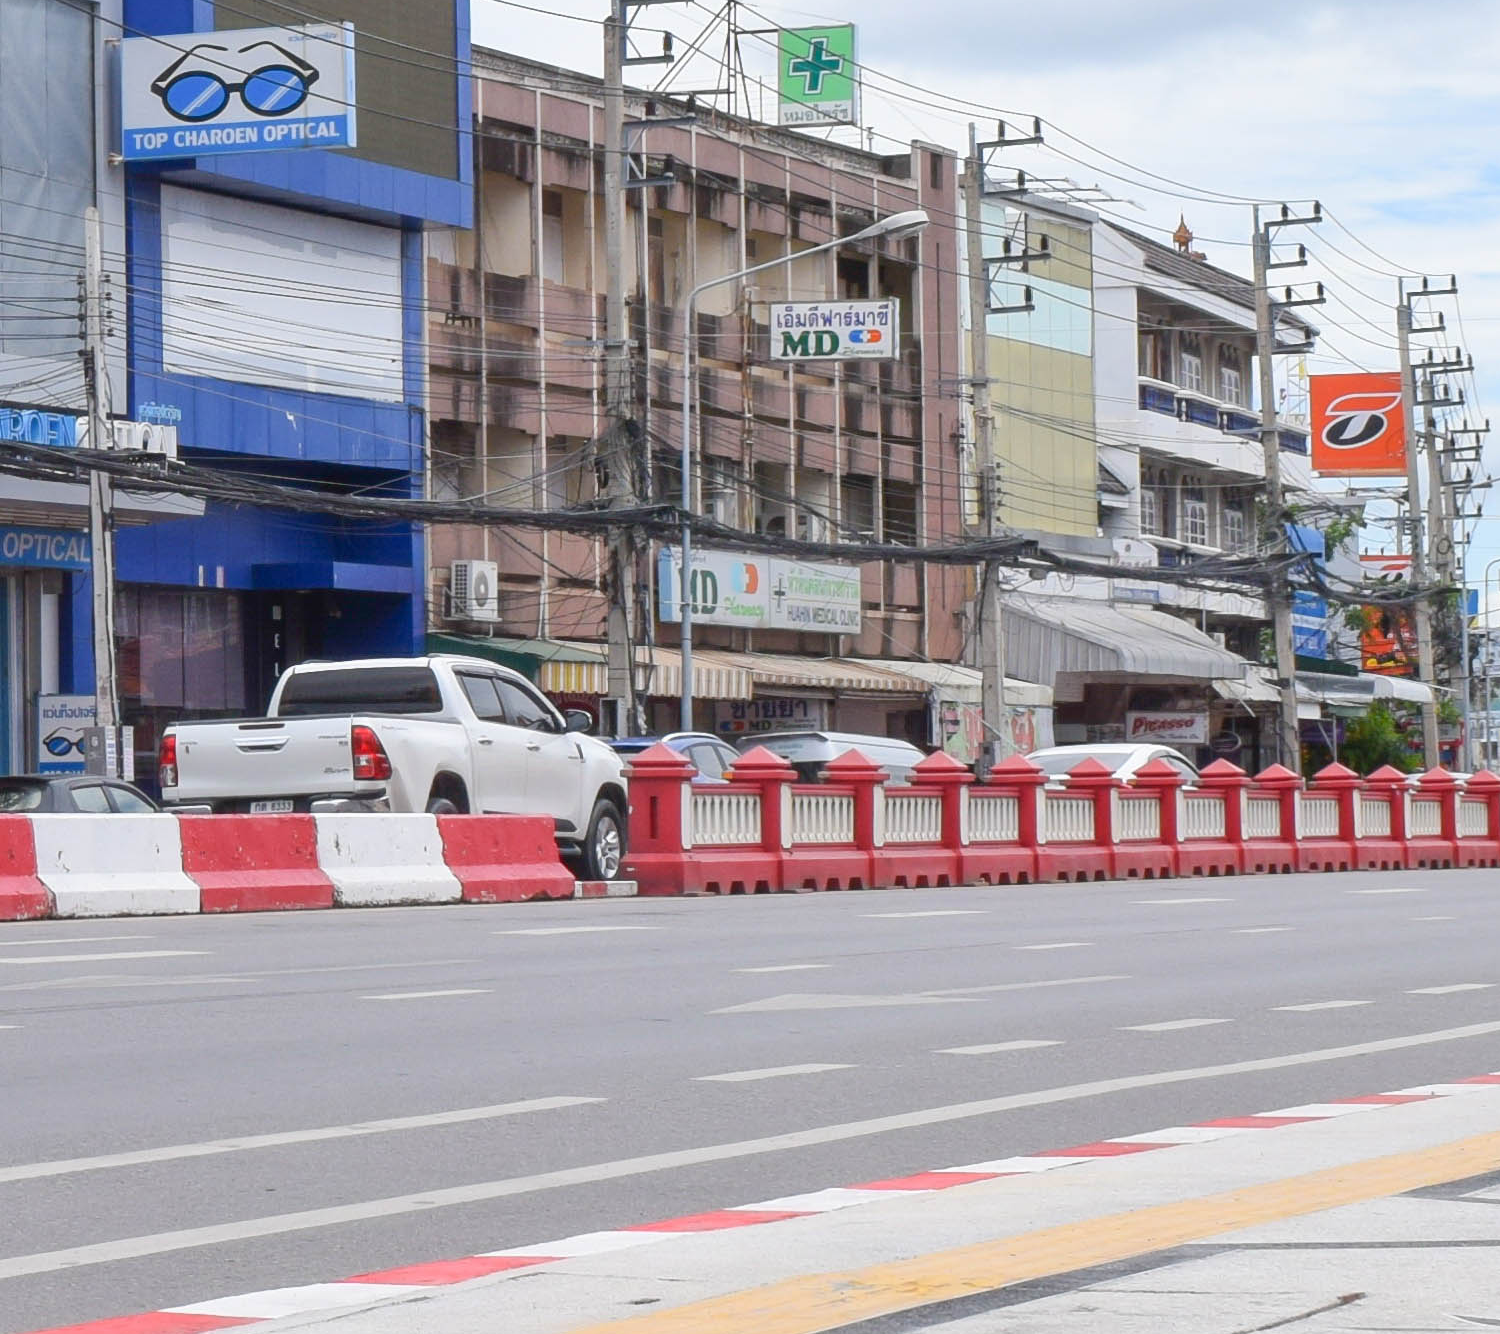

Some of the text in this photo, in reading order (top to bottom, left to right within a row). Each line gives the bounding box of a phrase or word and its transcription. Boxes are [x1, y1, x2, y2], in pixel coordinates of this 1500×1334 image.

[133, 121, 340, 150] TOP CHAROEN OPTICAL
[780, 329, 840, 357] MD
[2, 532, 91, 563] OPTICAL
